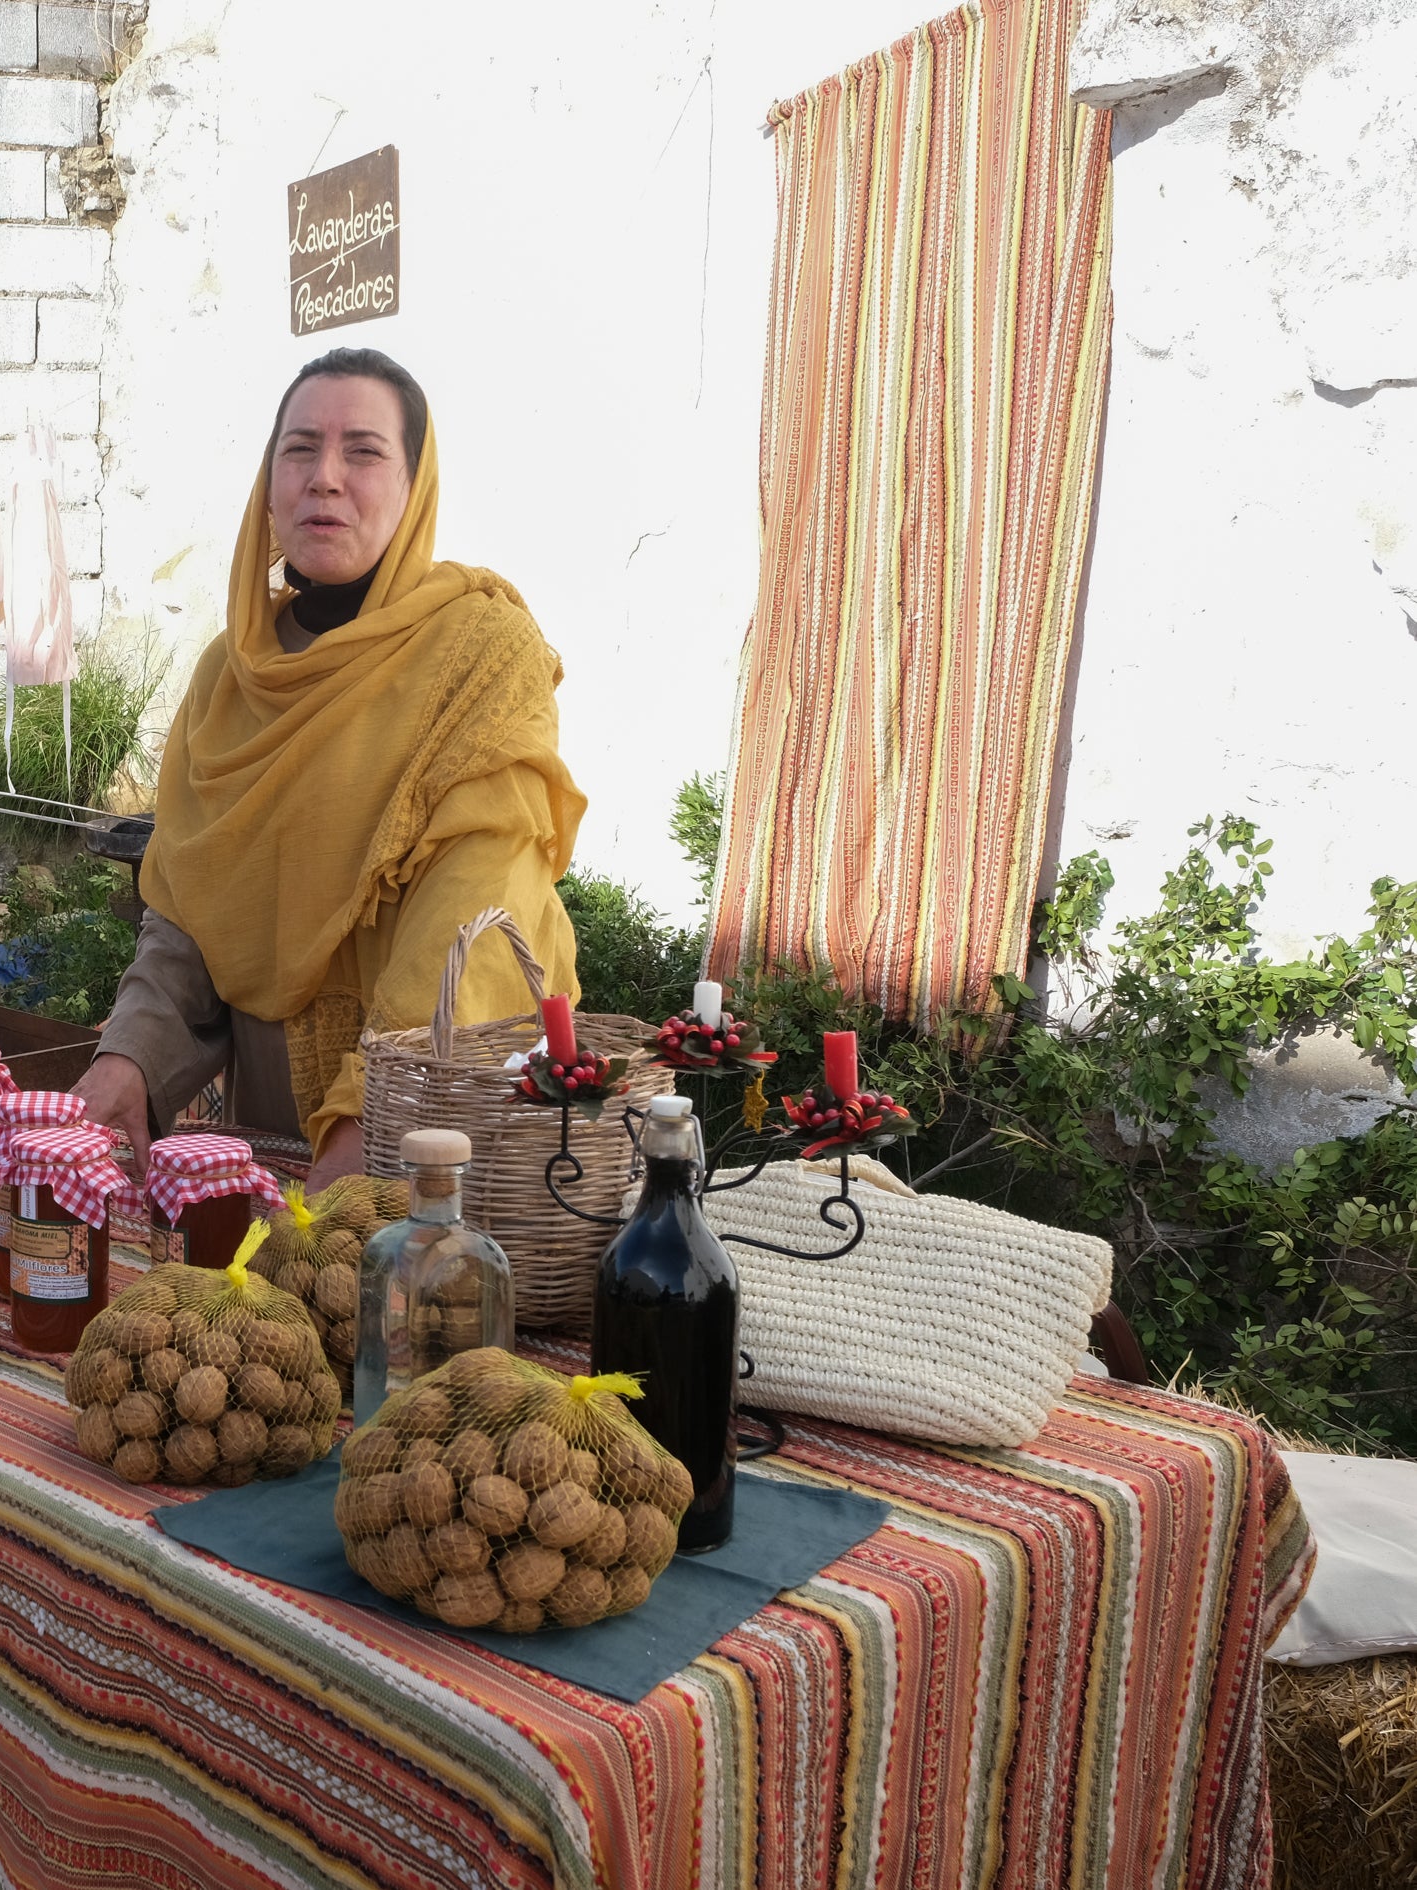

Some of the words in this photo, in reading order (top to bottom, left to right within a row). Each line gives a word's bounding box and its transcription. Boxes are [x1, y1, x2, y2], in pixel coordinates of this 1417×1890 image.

[289, 190, 395, 266] Lavanderas
[295, 261, 394, 333] Pescadores
[17, 1258, 68, 1273] Milflores
